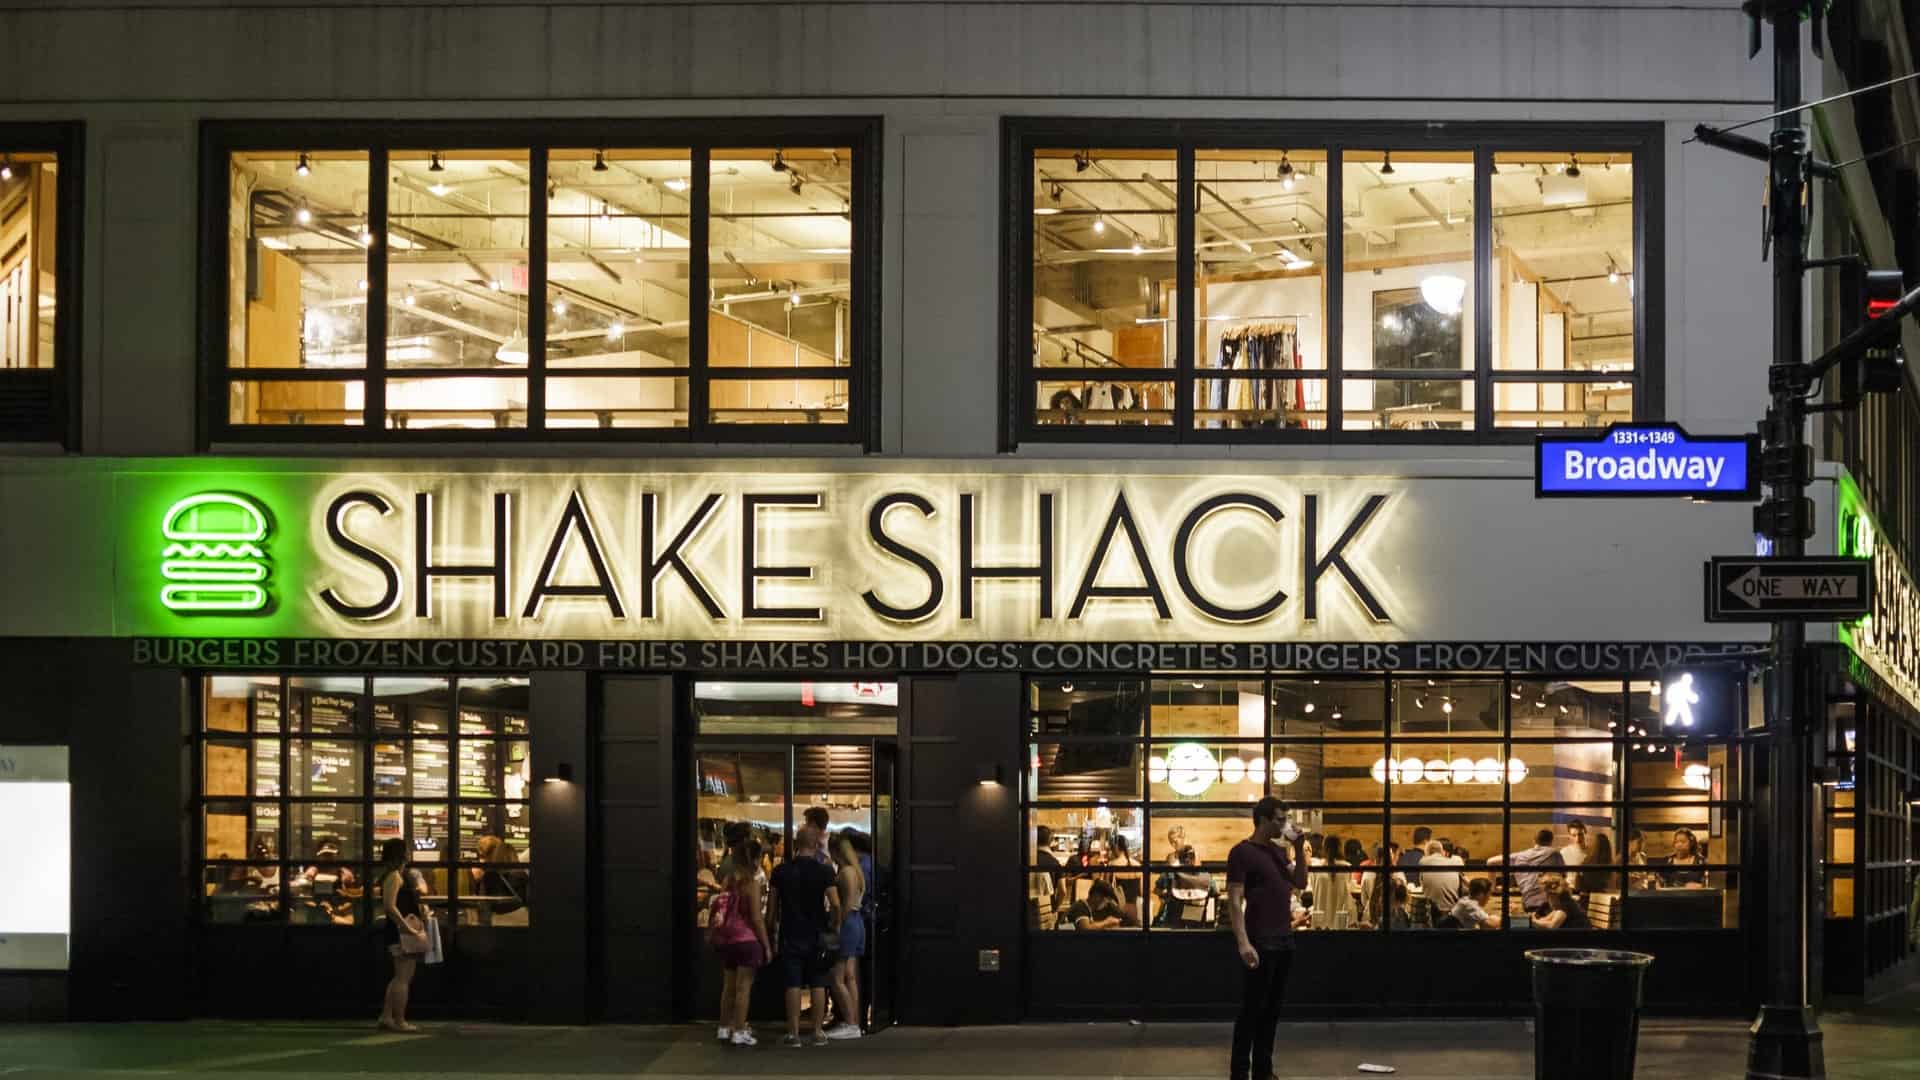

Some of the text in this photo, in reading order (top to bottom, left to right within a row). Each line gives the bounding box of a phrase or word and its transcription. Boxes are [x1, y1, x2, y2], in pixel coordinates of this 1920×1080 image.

[1565, 448, 1725, 488] Broadway
[319, 489, 1391, 623] SHAKE SHACK
[1743, 578, 1846, 597] ONE WAY
[132, 640, 281, 665] BURGERS
[294, 640, 425, 666] FROZEN
[431, 641, 585, 667] CUSTARD
[599, 641, 687, 668] FRIES
[701, 642, 829, 668] SHAKES
[843, 642, 913, 669] HOT
[922, 642, 1019, 669] DOGS
[1031, 643, 1239, 670] CONCRETES
[1249, 643, 1401, 670] BURGERS
[1415, 643, 1548, 671] FROZEN
